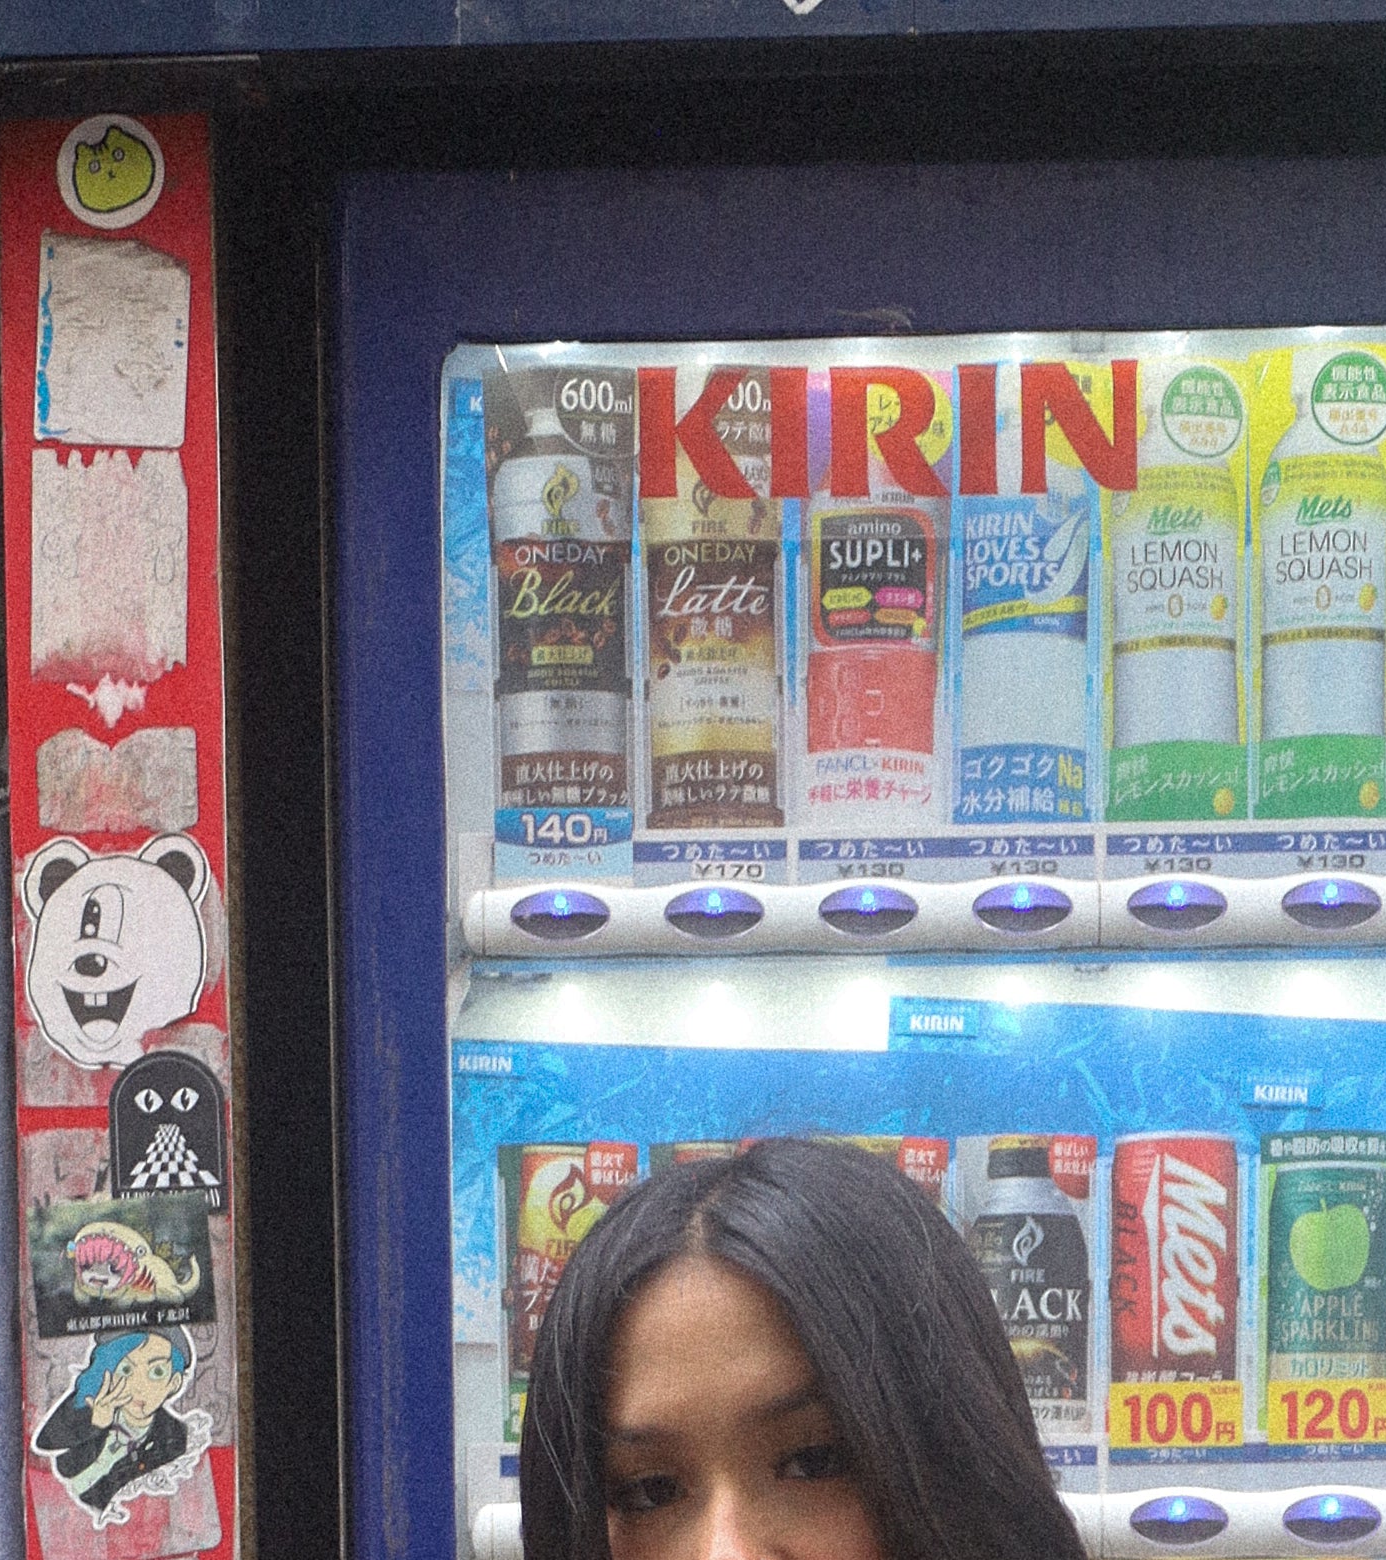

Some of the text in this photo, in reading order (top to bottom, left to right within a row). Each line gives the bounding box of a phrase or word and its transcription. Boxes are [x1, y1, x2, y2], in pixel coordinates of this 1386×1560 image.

[560, 378, 634, 415] 600ml
[636, 359, 1139, 499] KIRIN
[965, 511, 1036, 537] KIRIN
[1295, 494, 1354, 527] Mets
[846, 519, 903, 537] amino
[514, 544, 609, 565] ONEDAY
[663, 542, 757, 564] ONEDAY
[964, 536, 1041, 563] LOVES
[1130, 539, 1219, 566] LEMON
[1278, 530, 1369, 558] LEMON
[965, 562, 1060, 591] SPORTS
[1126, 567, 1226, 594] SQUASH
[1275, 556, 1374, 585] SQUASH
[501, 566, 618, 619] Black
[656, 565, 770, 617] Latte
[1058, 753, 1084, 790] Na
[961, 786, 1056, 816] 水分補給
[520, 812, 610, 845] 140円
[694, 862, 764, 879] ¥170
[909, 1013, 965, 1033] KIRIN
[1253, 1083, 1308, 1103] KIRIN
[1111, 1199, 1140, 1318] BLACK
[1159, 1153, 1229, 1362] Mets
[1297, 1290, 1365, 1318] APPLE
[1121, 1392, 1237, 1444] 100円
